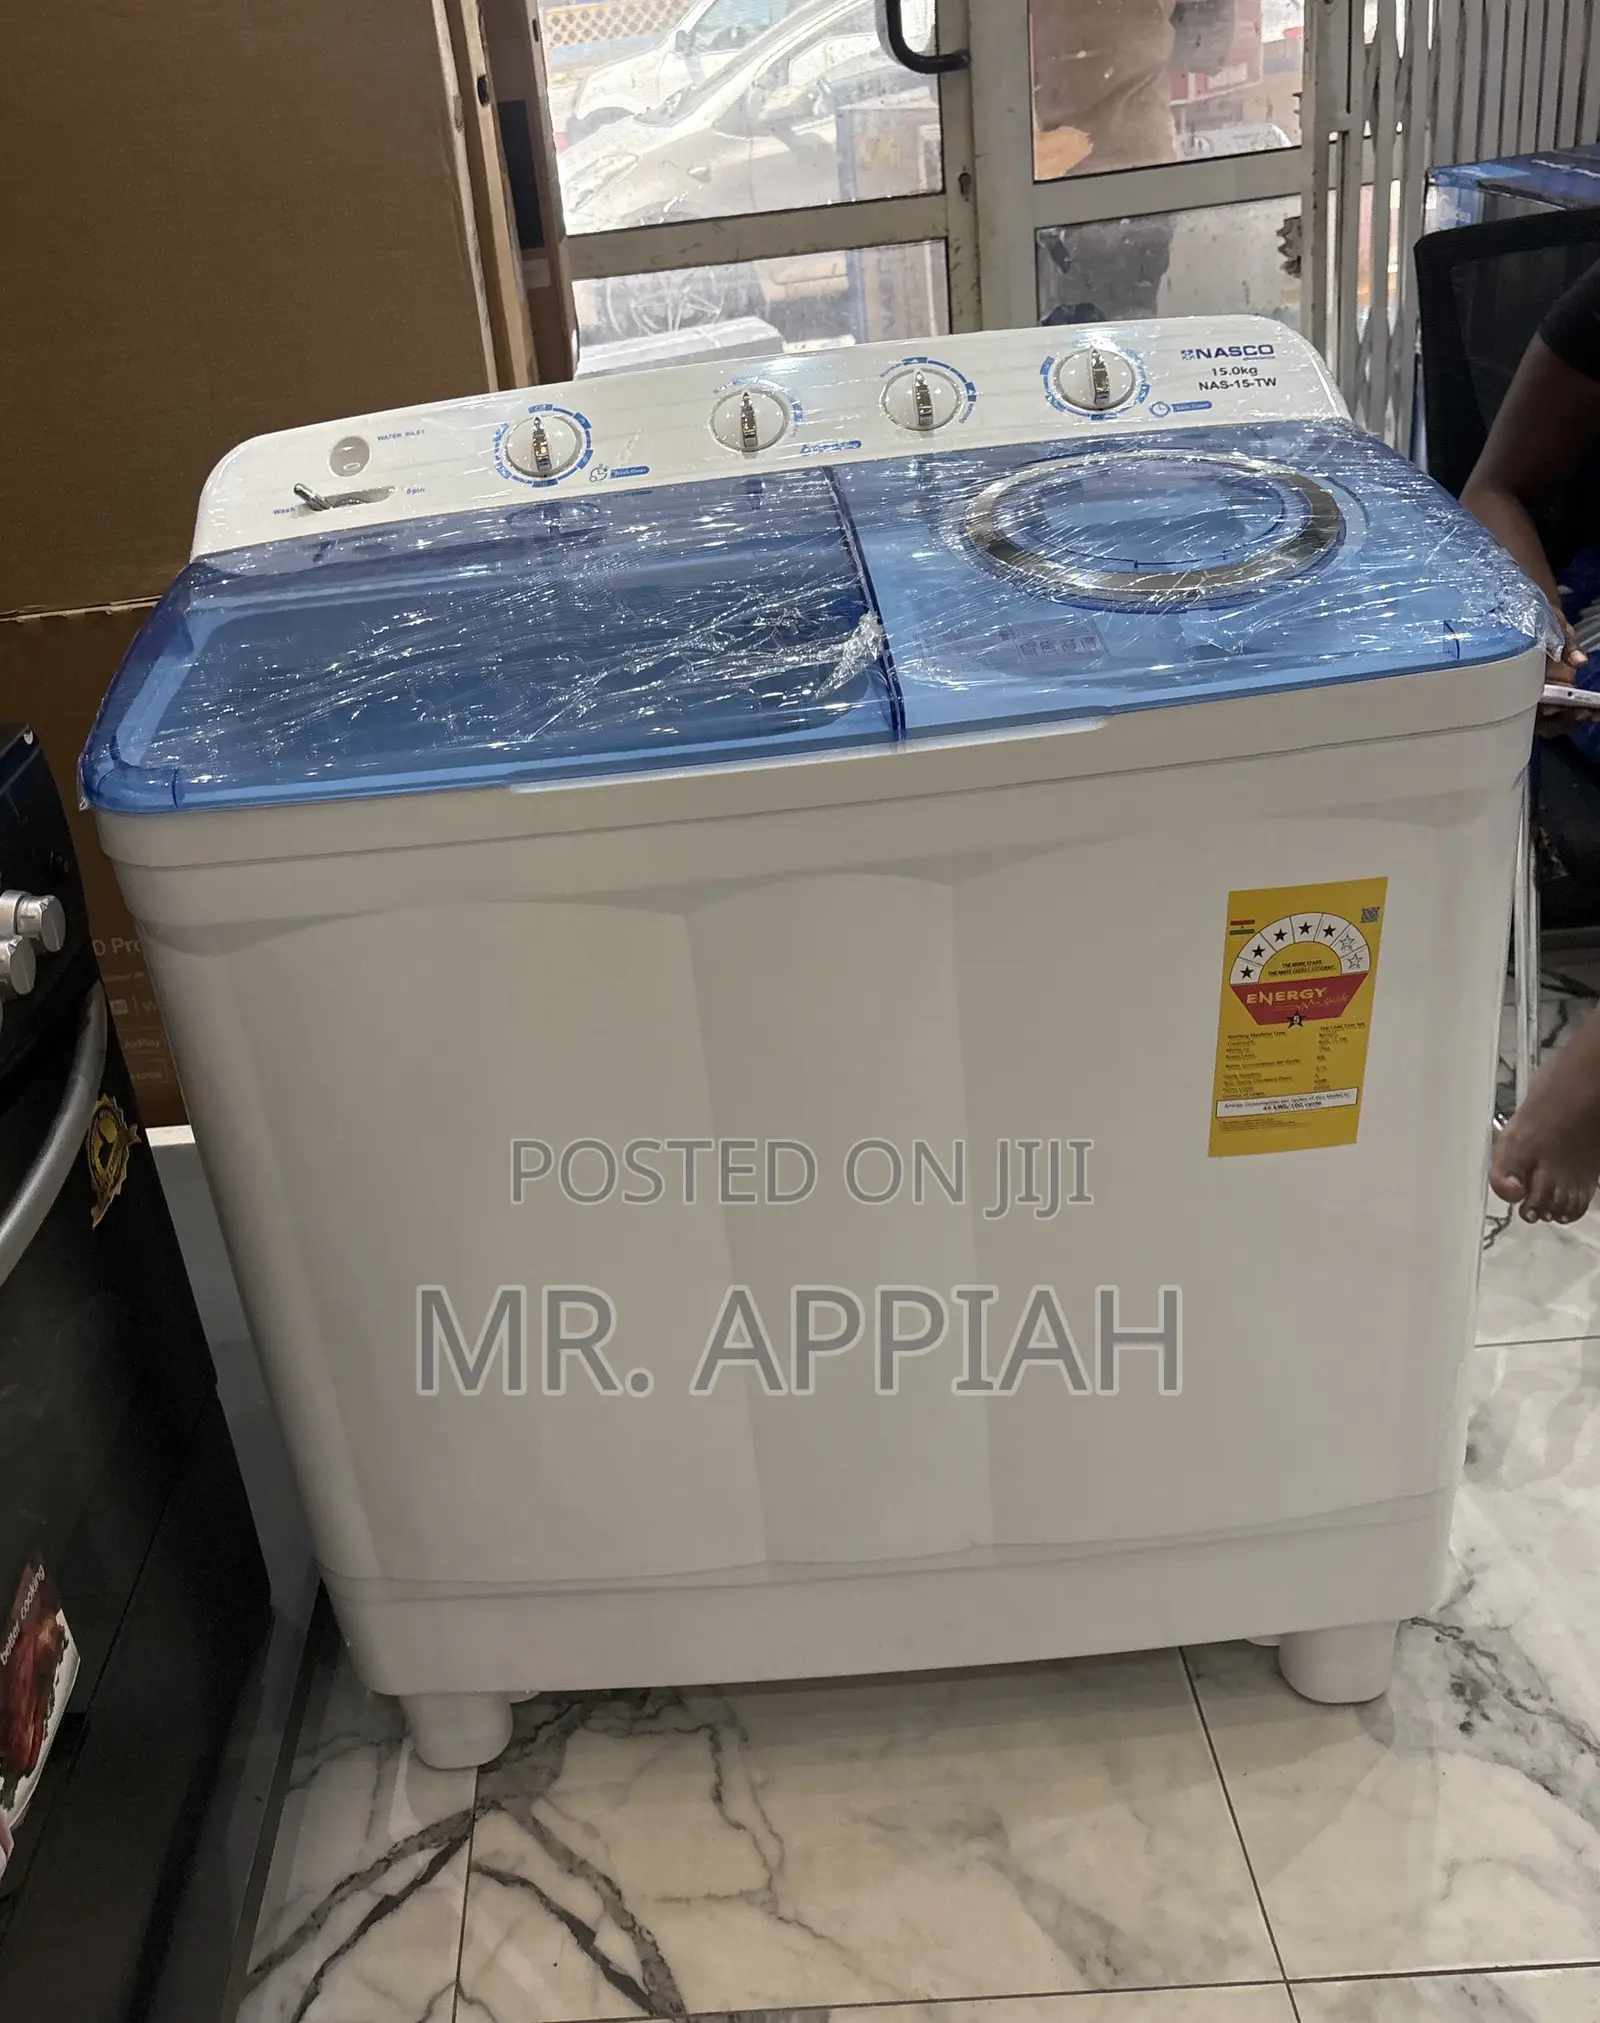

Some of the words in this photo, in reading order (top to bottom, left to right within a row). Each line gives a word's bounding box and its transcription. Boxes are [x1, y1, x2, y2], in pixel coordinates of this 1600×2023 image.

[1195, 344, 1275, 359] NASCO
[1211, 366, 1258, 377] 15.0kg
[1198, 377, 1277, 391] NAS-15-TW
[376, 432, 402, 442] WATER
[405, 487, 425, 496] Spin
[272, 506, 296, 515] Wash
[1246, 987, 1327, 1005] ENERGY
[1293, 1015, 1300, 1024] 5
[0, 1621, 21, 1666] better
[20, 1564, 45, 1620] cooking
